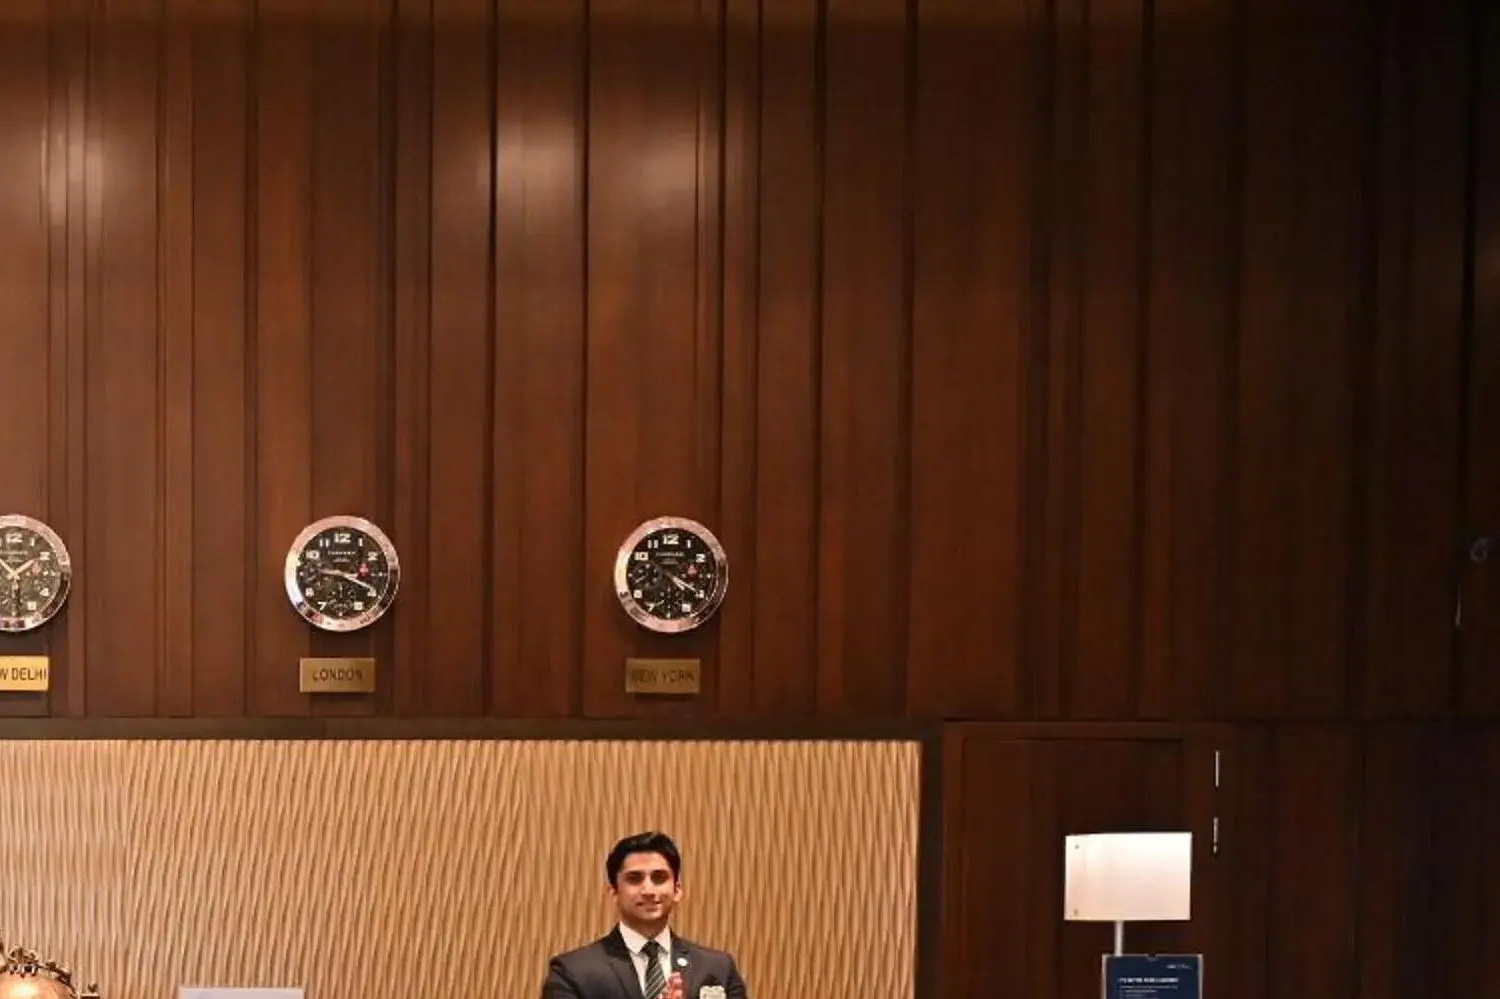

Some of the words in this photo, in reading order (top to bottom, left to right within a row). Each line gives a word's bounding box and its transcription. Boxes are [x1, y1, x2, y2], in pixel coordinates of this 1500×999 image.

[334, 532, 351, 543] 12
[663, 534, 679, 545] 12
[305, 550, 320, 560] 10
[634, 551, 649, 561] 10
[318, 601, 327, 611] 7
[11, 667, 47, 681] DELHI
[312, 668, 363, 682] LONDON
